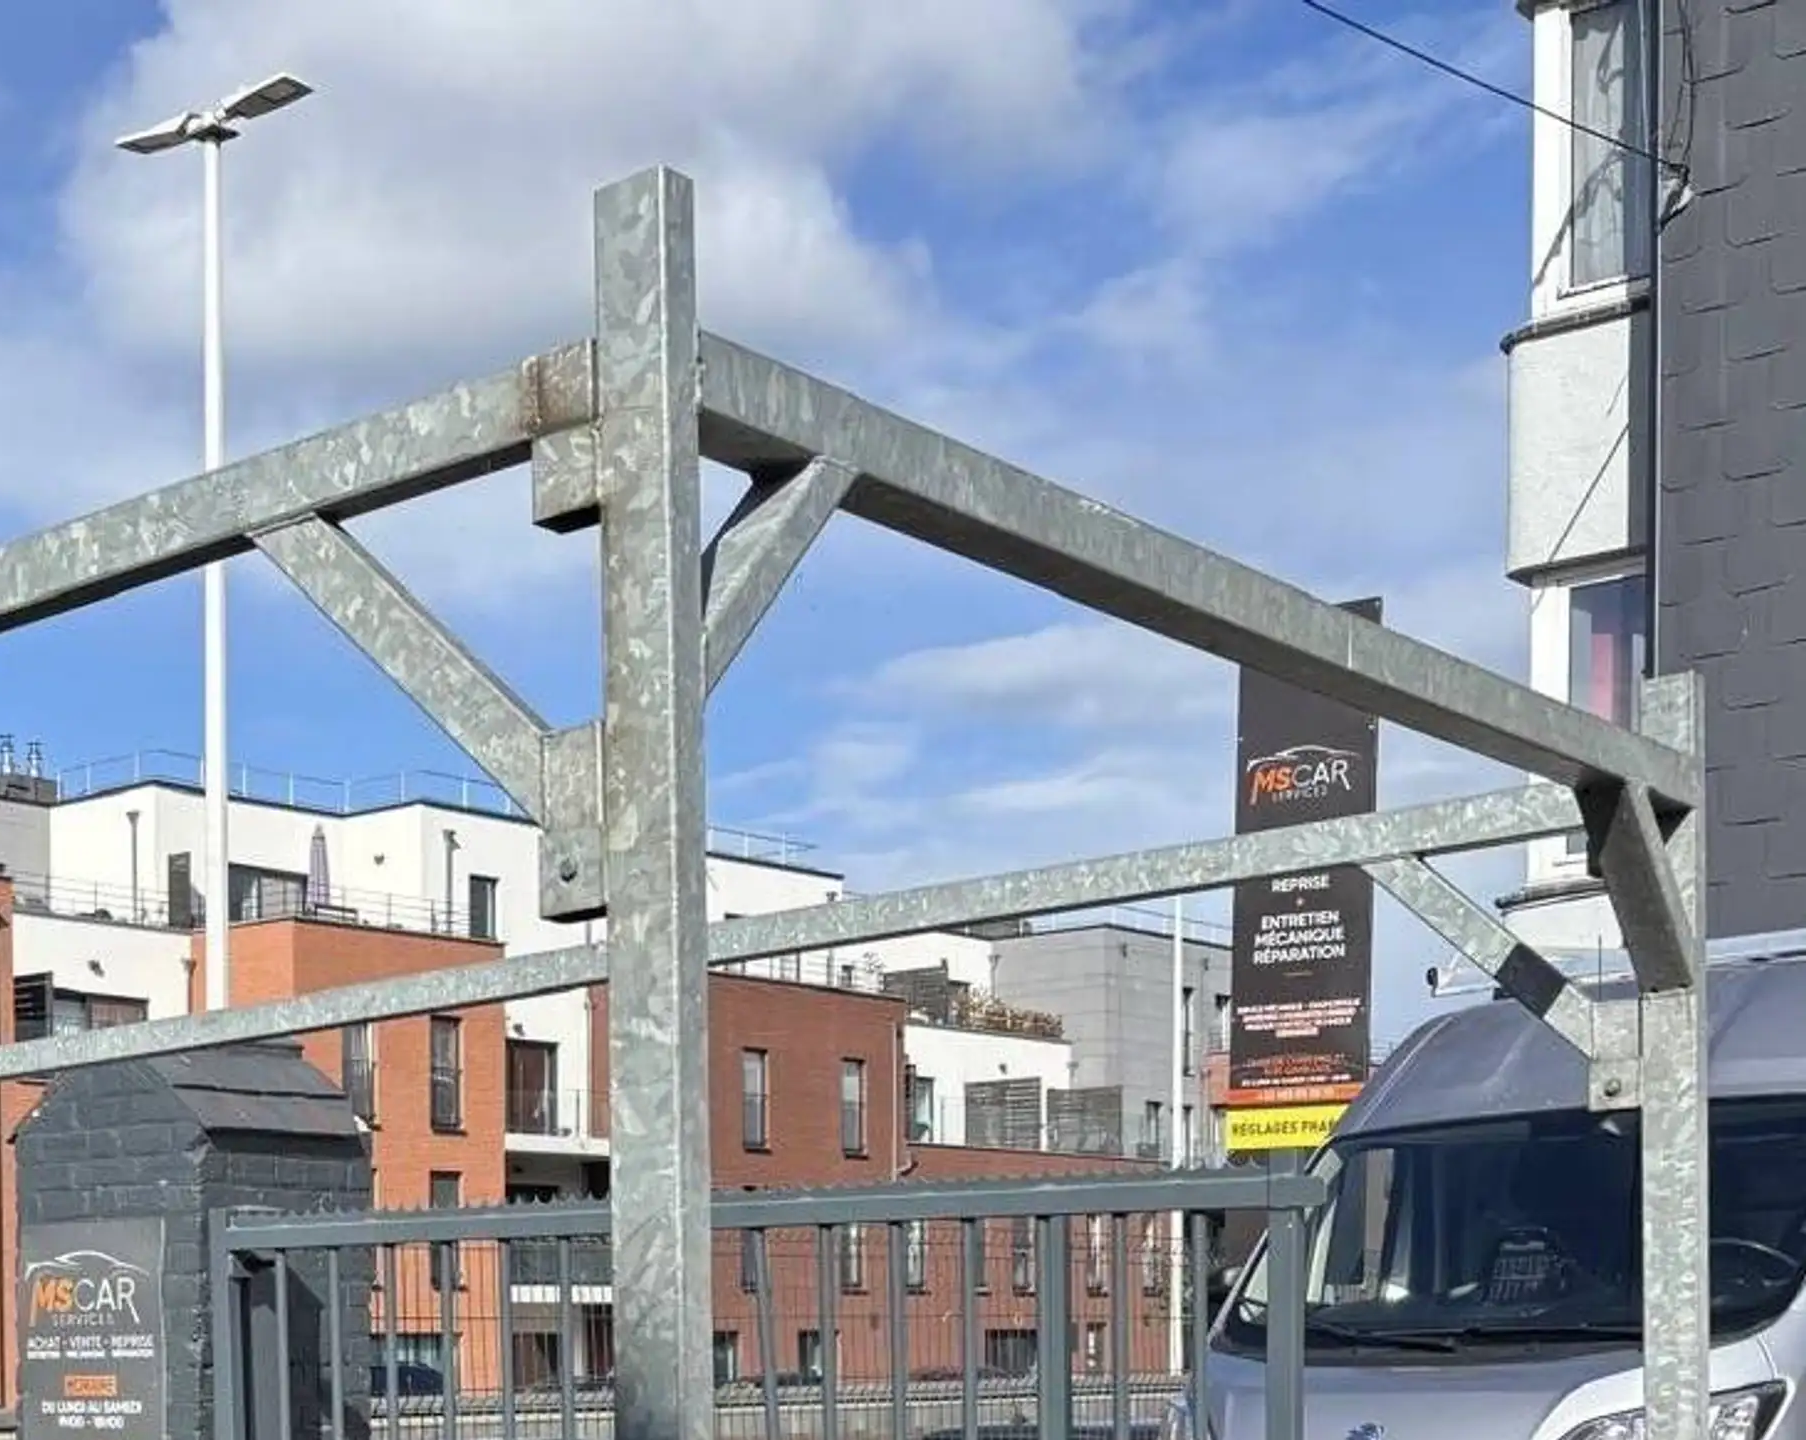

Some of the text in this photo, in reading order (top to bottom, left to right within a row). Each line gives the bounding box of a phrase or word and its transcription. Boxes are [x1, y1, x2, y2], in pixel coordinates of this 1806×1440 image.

[1271, 873, 1330, 892] REPRISE
[1261, 910, 1340, 931] ENTRETIEN
[1254, 925, 1345, 949] MÉCANIQUE
[1253, 943, 1346, 965] RÉPARATION
